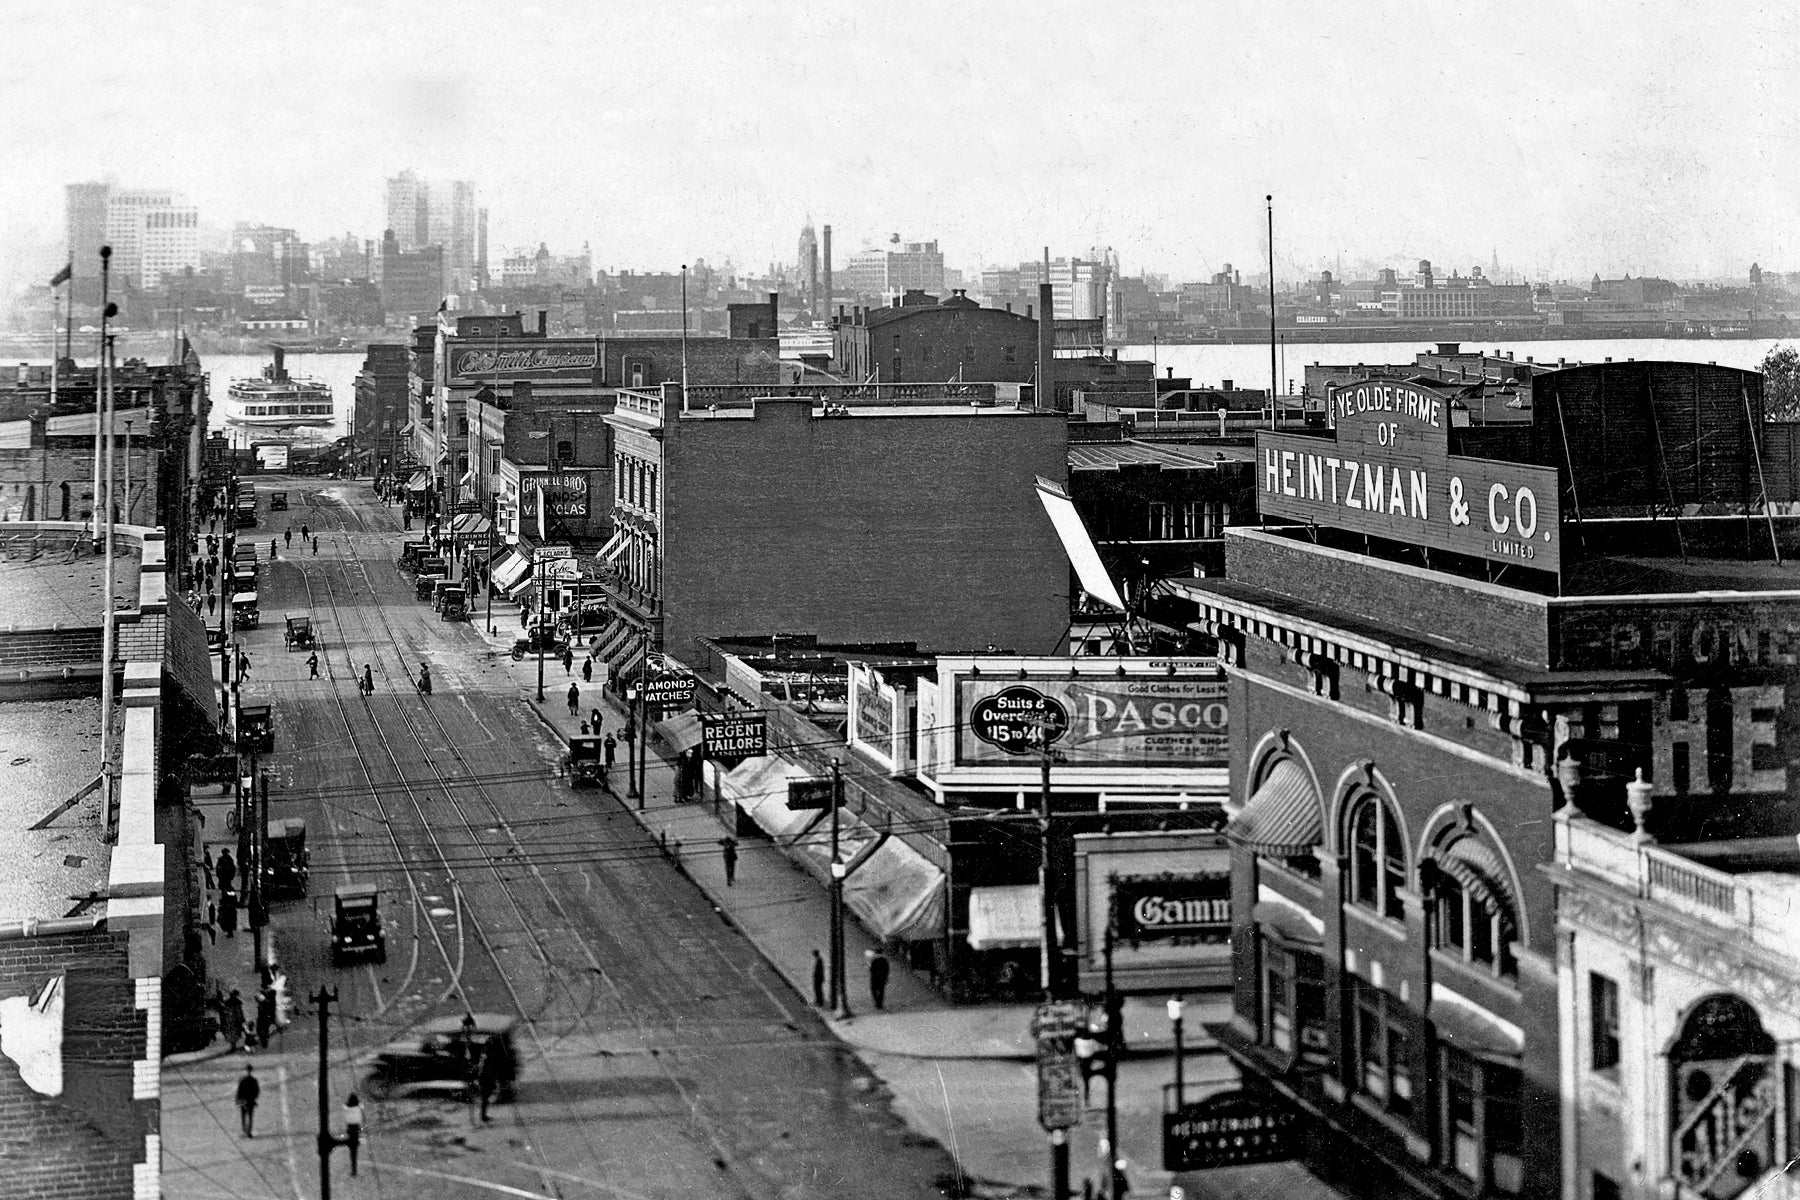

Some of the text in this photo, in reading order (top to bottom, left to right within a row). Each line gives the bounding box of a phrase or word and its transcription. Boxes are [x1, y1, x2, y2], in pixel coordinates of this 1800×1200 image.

[1336, 390, 1355, 418] YE
[1357, 386, 1392, 413] OLDE
[1396, 388, 1441, 428] FIRME
[1377, 422, 1398, 447] OF
[522, 476, 561, 493] GRINNLL
[1265, 448, 1551, 542] HEINTZMAN & CO.
[523, 504, 586, 515] VIOLAS
[1492, 539, 1535, 559] LIMITED
[636, 679, 694, 691] DAMONDS
[1128, 684, 1149, 693] Good
[1151, 684, 1180, 693] Clothes
[1183, 684, 1194, 693] for
[1197, 684, 1216, 693] Less
[998, 697, 1045, 709] Suits &
[983, 708, 1057, 722] Overcs
[705, 723, 763, 739] REGENT
[987, 725, 1010, 742] $15
[706, 737, 763, 751] TAILORS
